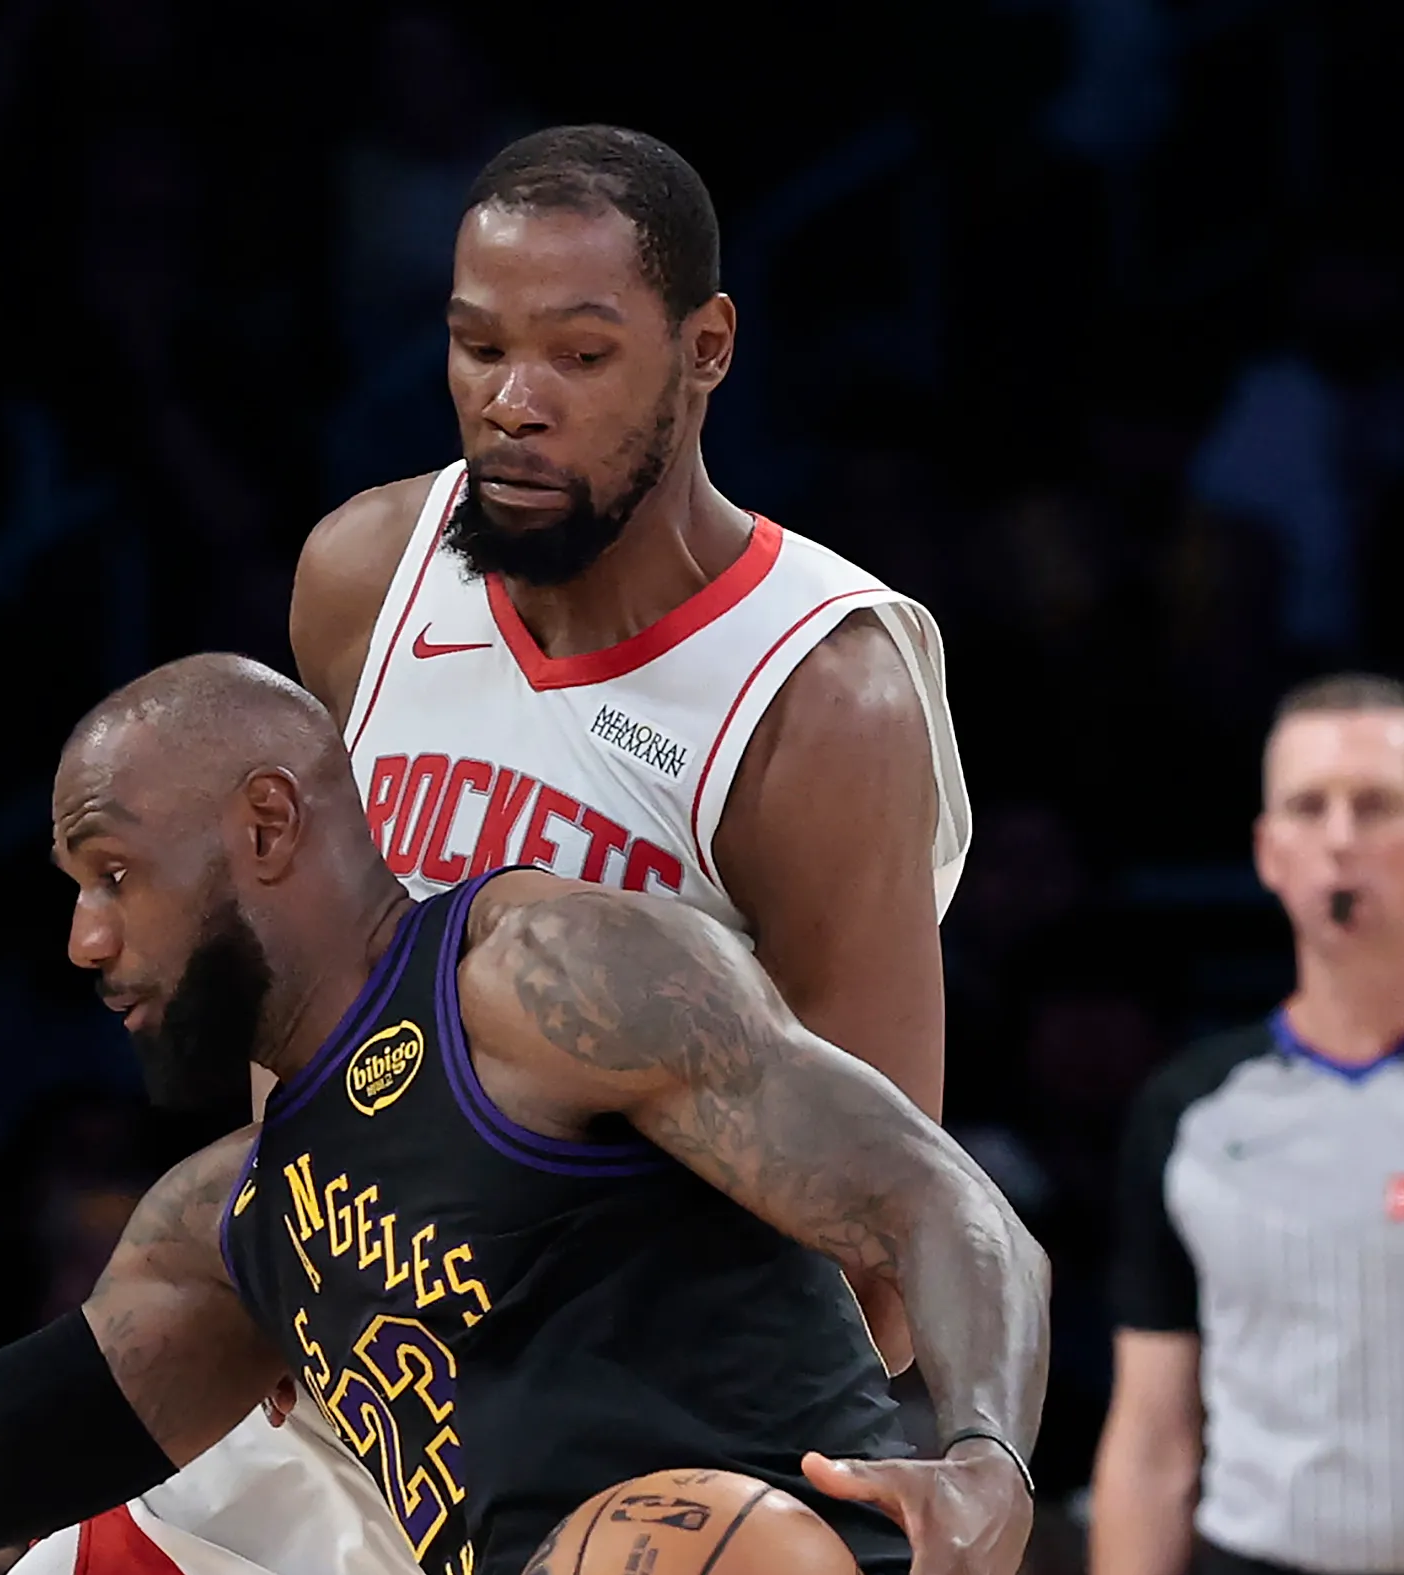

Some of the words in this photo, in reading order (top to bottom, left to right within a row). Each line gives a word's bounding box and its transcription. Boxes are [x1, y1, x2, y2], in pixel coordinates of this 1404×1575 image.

[590, 714, 686, 779] HERMANN
[595, 704, 688, 764] MEMORIAL
[352, 1039, 419, 1091] bibigo
